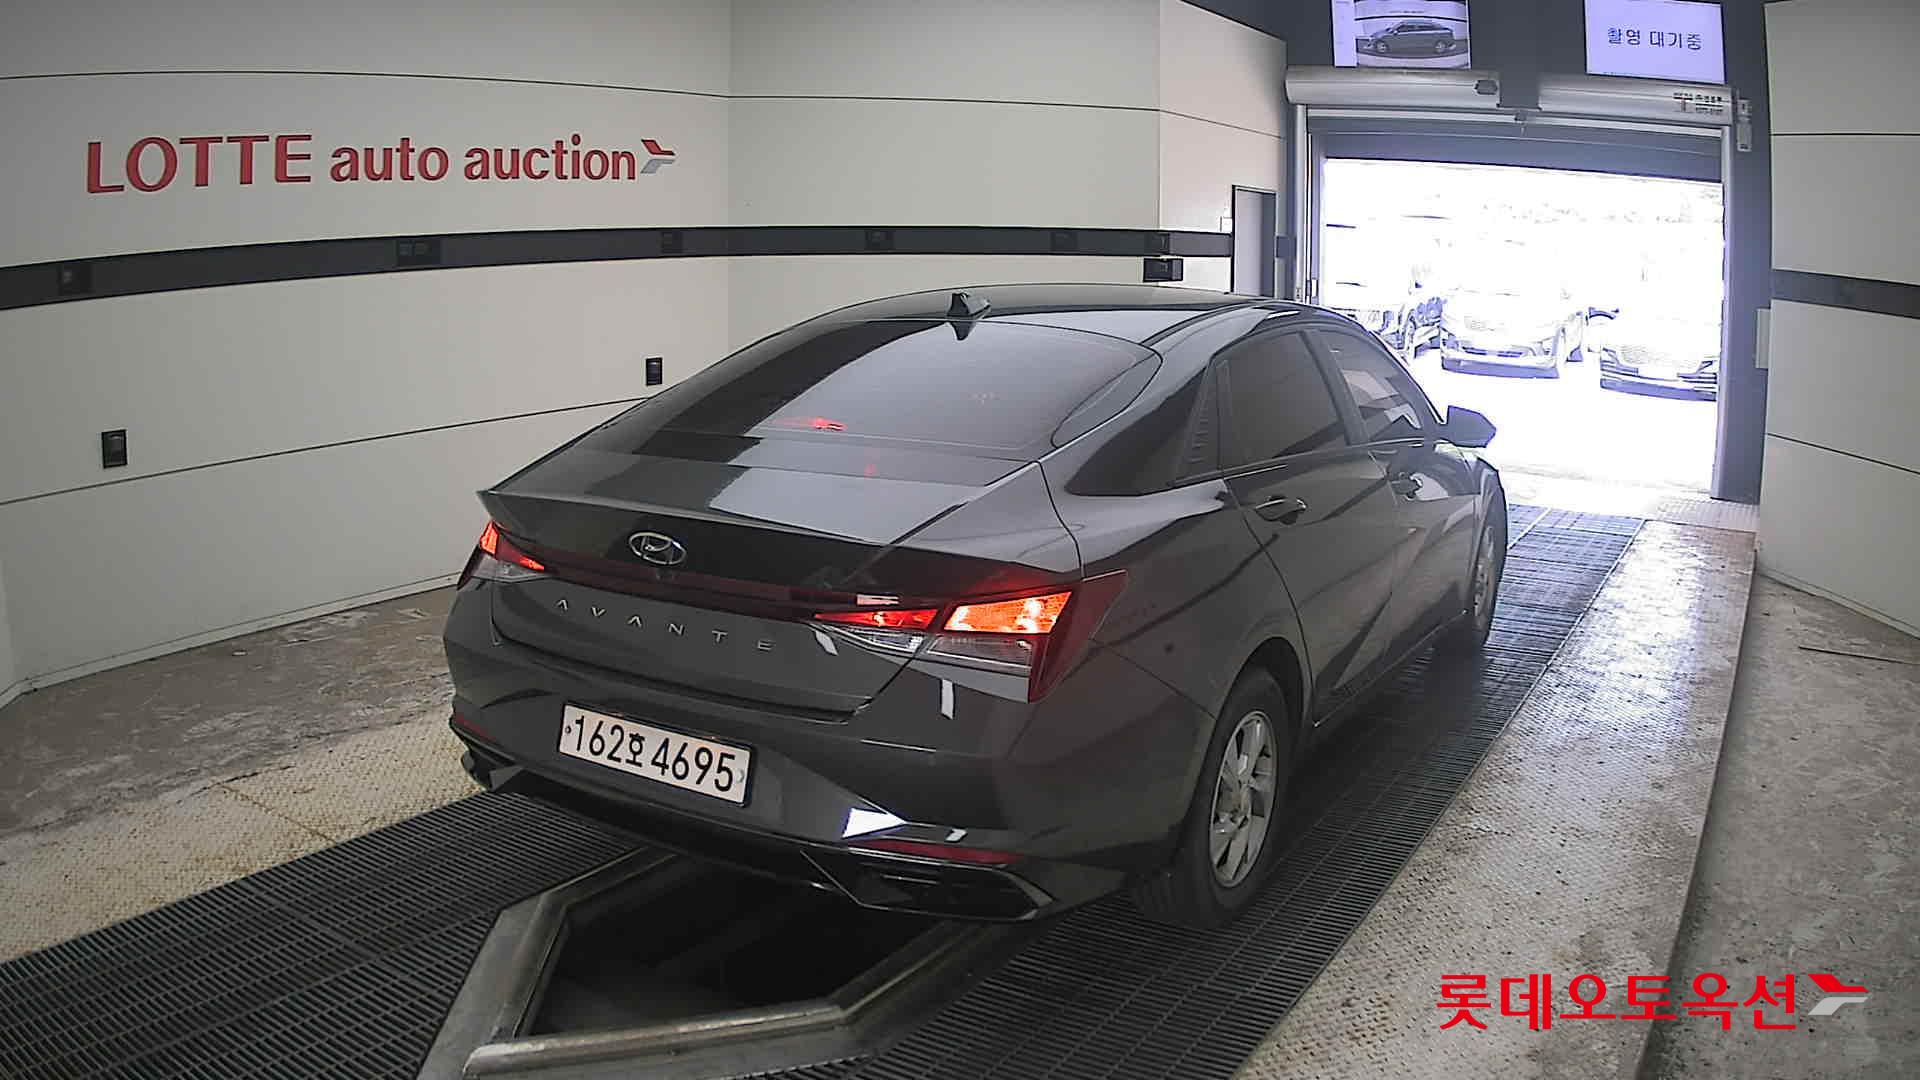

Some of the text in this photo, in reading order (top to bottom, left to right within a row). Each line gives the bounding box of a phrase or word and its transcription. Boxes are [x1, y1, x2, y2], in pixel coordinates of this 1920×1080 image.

[1607, 27, 1702, 51] 촬영 대기중
[86, 133, 638, 193] LOTTE auto auction
[556, 598, 777, 652] AVANTE
